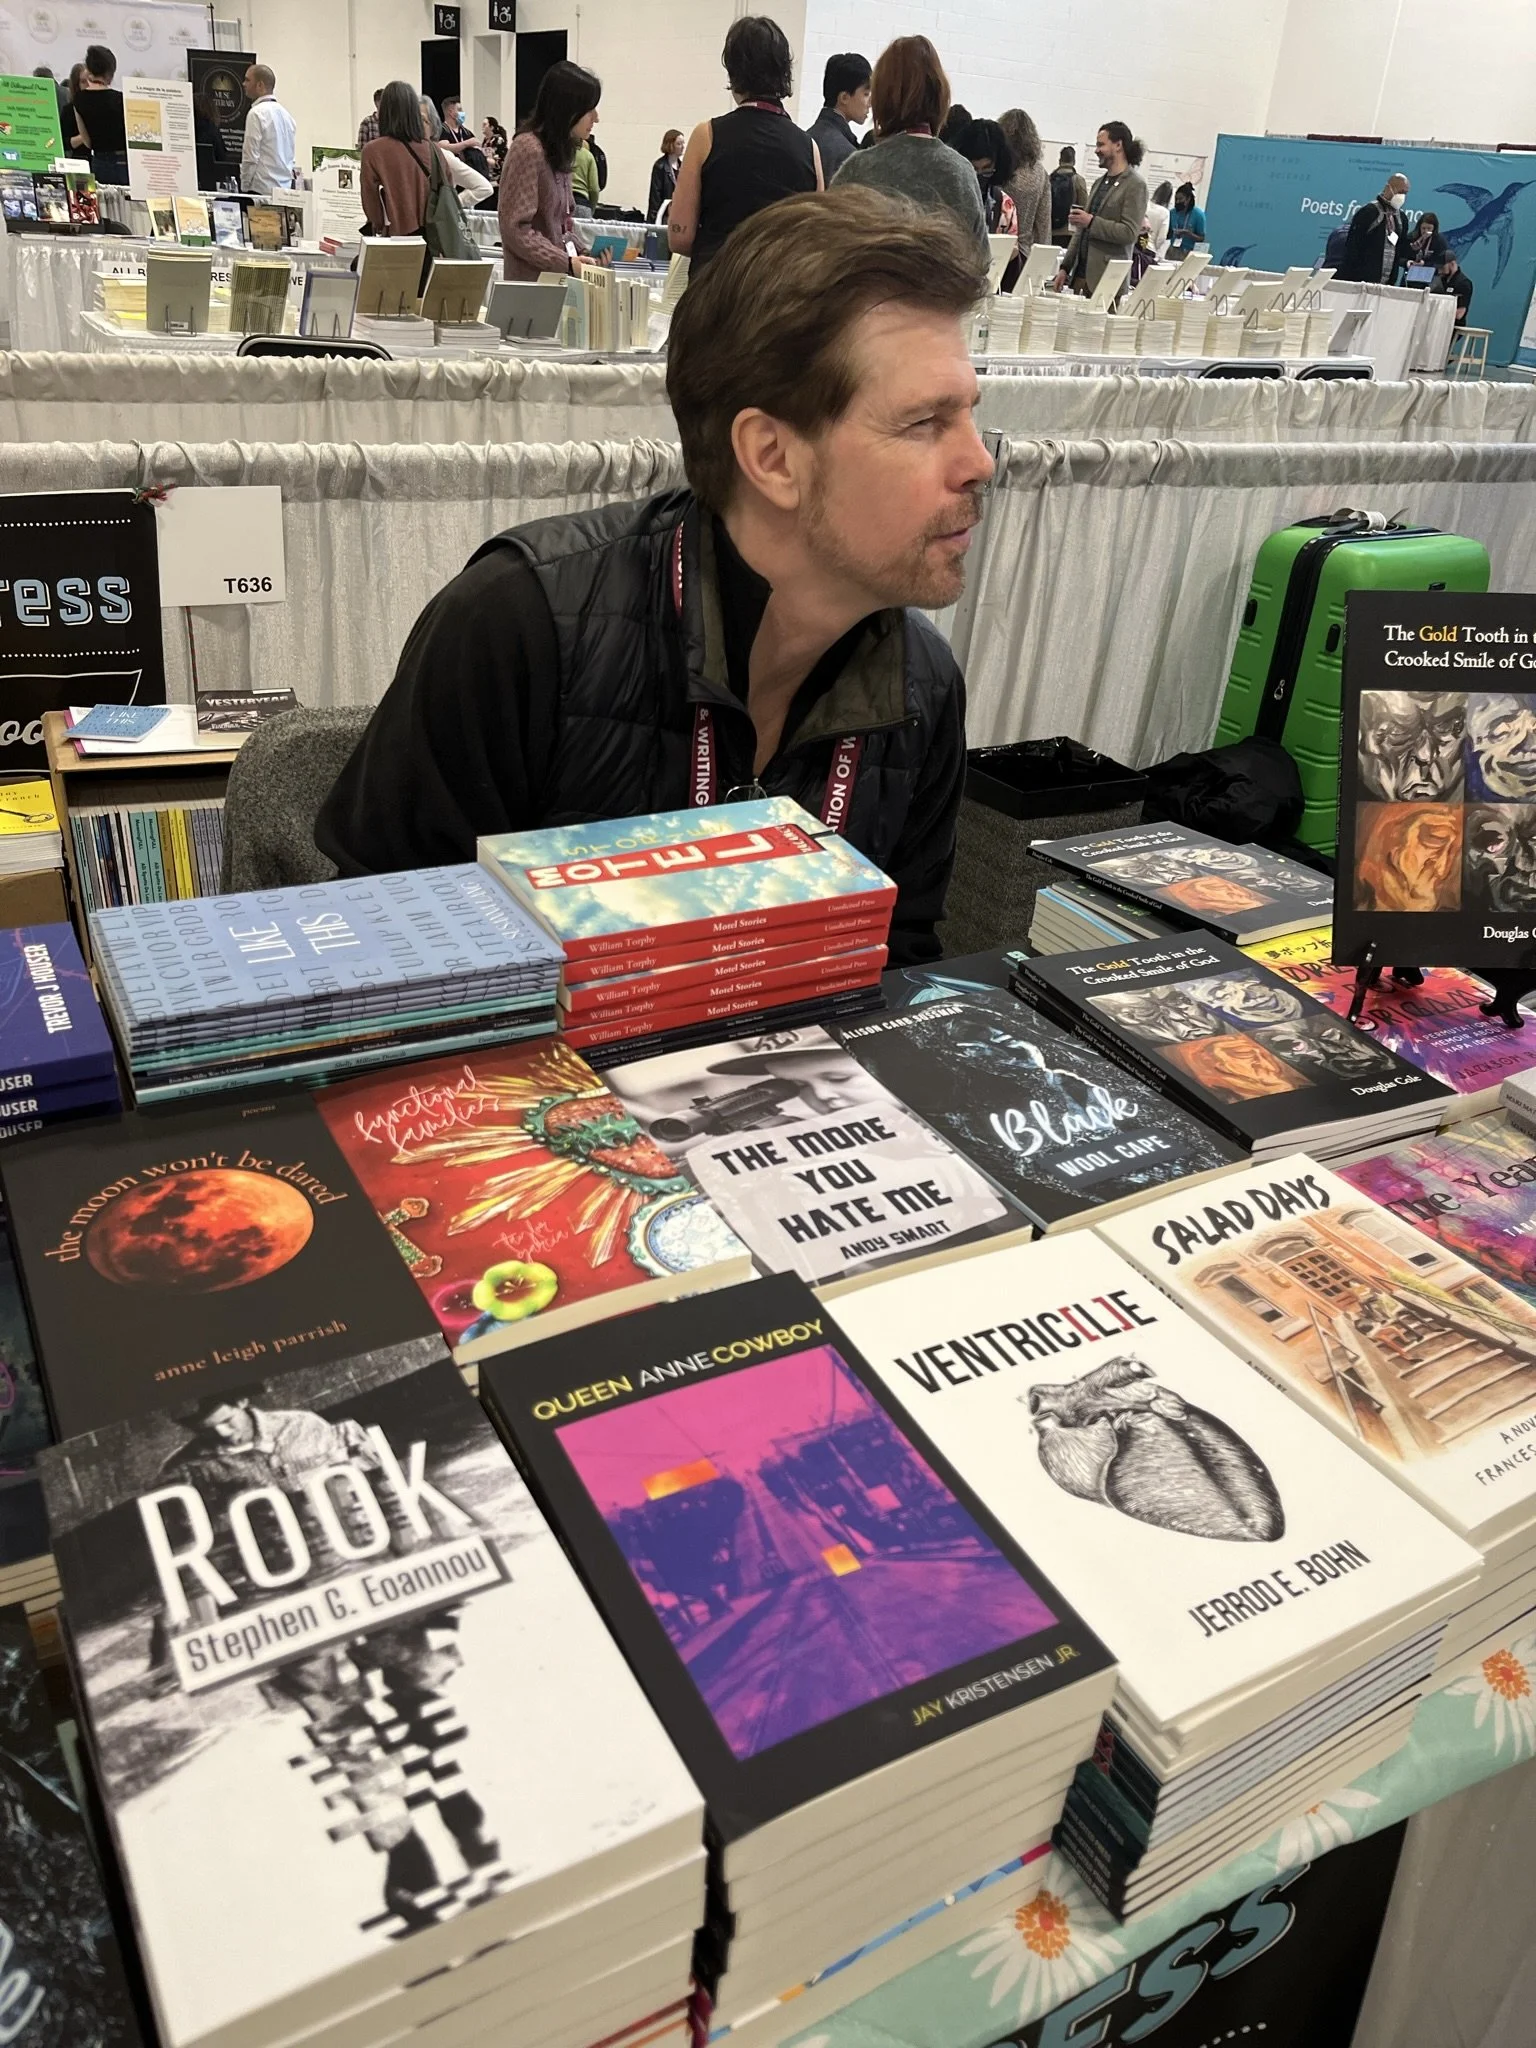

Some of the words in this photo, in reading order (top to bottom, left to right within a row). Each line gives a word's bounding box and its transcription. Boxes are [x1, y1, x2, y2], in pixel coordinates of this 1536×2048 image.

[1301, 197, 1344, 216] Poets
[224, 577, 273, 594] T636
[1384, 624, 1415, 641] The
[1419, 626, 1457, 642] Gold
[1462, 627, 1509, 644] Tooth
[1513, 628, 1528, 644] in
[1384, 650, 1450, 668] Crooked
[1453, 652, 1495, 669] Smile
[1499, 652, 1516, 669] of
[1519, 653, 1536, 669] Go
[700, 708, 709, 720] &
[695, 727, 710, 806] WRITING
[836, 755, 851, 778] OF
[529, 833, 774, 887] MOTEL
[1066, 842, 1089, 853] The
[1088, 840, 1115, 849] Gold
[1115, 835, 1146, 845] Tooth
[1147, 832, 1157, 840] in
[1081, 847, 1125, 858] Crooked
[1124, 841, 1151, 850] Smile
[1162, 836, 1186, 844] God
[228, 921, 296, 964] LIKE
[296, 912, 361, 955] THIS
[589, 939, 623, 953] William
[626, 934, 656, 949] Torphy
[713, 920, 737, 932] Motel
[739, 915, 767, 927] Stories
[24, 943, 57, 985] HOUSER
[590, 961, 623, 976] William
[626, 956, 657, 970] Torphy
[712, 941, 737, 953] Motel
[739, 936, 765, 948] Stories
[1066, 965, 1096, 976] The
[1096, 960, 1130, 972] Gold
[1129, 953, 1168, 965] Tooth
[1170, 951, 1183, 959] in
[1184, 946, 1207, 956] the
[1083, 970, 1139, 985] Crooked
[1139, 964, 1174, 977] Smile
[1175, 959, 1190, 970] of
[1190, 956, 1220, 967] God
[1279, 957, 1358, 983] DRE
[590, 1006, 623, 1020] William
[626, 1001, 655, 1015] Torphy
[710, 985, 734, 996] Motel
[736, 980, 762, 991] Stories
[596, 987, 629, 1002] William
[631, 981, 661, 995] Torphy
[714, 964, 738, 976] Motel
[740, 958, 766, 970] Stories
[38, 993, 73, 1034] TREVOR
[589, 1027, 623, 1042] William
[625, 1022, 653, 1036] Torphy
[707, 1004, 731, 1016] Motel
[732, 999, 758, 1011] Stories
[842, 1023, 882, 1041] ALISON
[883, 1016, 912, 1032] CARB
[1430, 1034, 1472, 1048] MEMOIR
[1442, 1043, 1473, 1054] HAPA
[1473, 1033, 1516, 1046] IDENTITY
[1350, 1081, 1397, 1098] Douglas
[1399, 1075, 1422, 1087] Cole
[1456, 1055, 1521, 1079] JACKSON
[242, 1104, 276, 1117] poems
[990, 1087, 1138, 1158] Black
[712, 1137, 788, 1175] THE
[787, 1117, 897, 1158] MORE
[1056, 1150, 1118, 1178] WOOL
[1115, 1135, 1172, 1159] CAPE
[794, 1159, 877, 1195] YOU
[45, 1231, 83, 1263] the
[70, 1173, 138, 1228] moon
[141, 1151, 230, 1178] won't
[237, 1150, 273, 1170] be
[276, 1161, 349, 1205] dared
[778, 1196, 887, 1243] HATE
[889, 1180, 953, 1216] ME
[1153, 1202, 1254, 1266] SALAD
[1245, 1174, 1331, 1222] DAYS
[1388, 1190, 1462, 1226] The
[840, 1235, 890, 1260] ANDY
[891, 1220, 952, 1246] SMART
[154, 1361, 207, 1383] anne
[213, 1340, 267, 1368] leigh
[273, 1320, 349, 1355] parrish
[532, 1373, 633, 1421] QUEEN
[639, 1351, 715, 1388] ANNE
[713, 1318, 825, 1366] COWBOY
[1500, 1431, 1514, 1444] A
[1512, 1414, 1536, 1437] NOV
[185, 1603, 319, 1673] Stephen
[330, 1588, 358, 1621] G.
[363, 1544, 489, 1609] Eoannou
[1187, 1566, 1286, 1638] JERROD
[1277, 1562, 1310, 1599] E.
[1294, 1540, 1371, 1589] BOHN
[911, 1699, 945, 1727] JAY
[945, 1654, 1055, 1709] KRISTENSEN
[984, 1862, 1311, 2048] ESS
